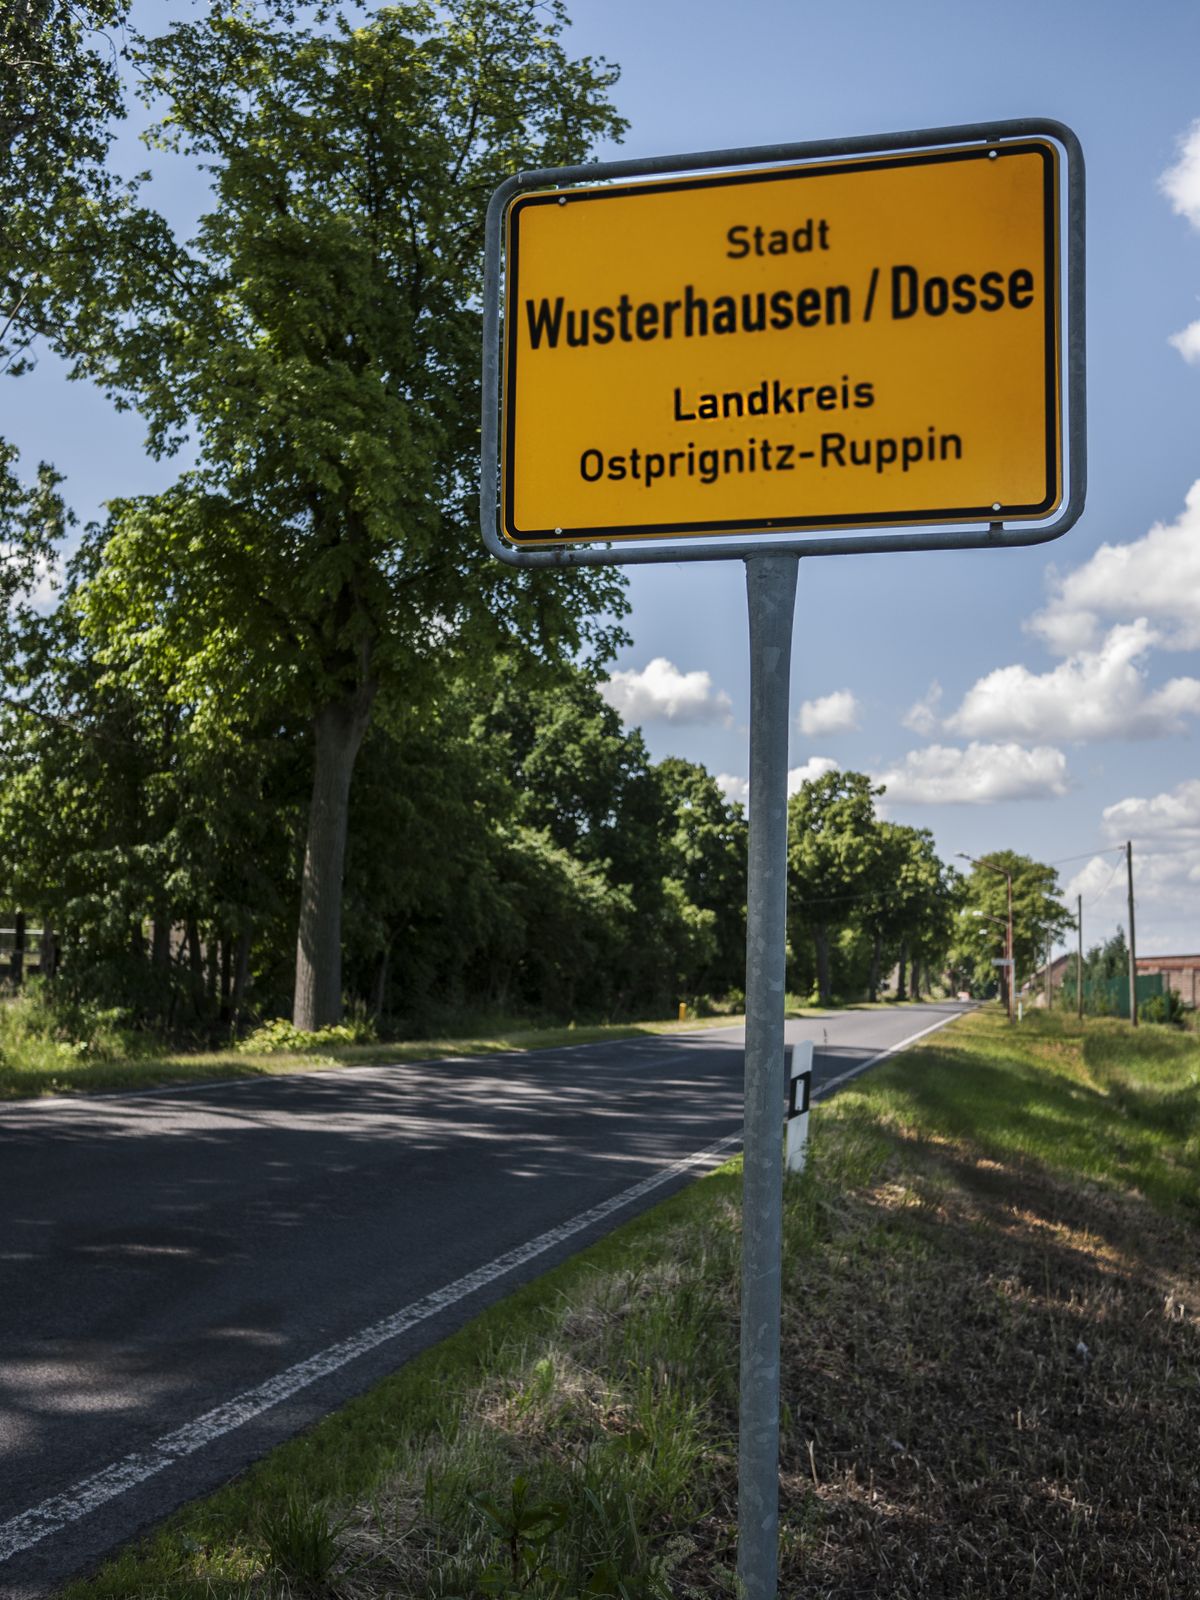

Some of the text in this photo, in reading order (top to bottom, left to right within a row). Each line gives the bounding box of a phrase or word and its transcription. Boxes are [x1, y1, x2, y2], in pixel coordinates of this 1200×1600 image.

[726, 217, 831, 260] Stadt
[674, 375, 875, 422] Landkreis
[580, 426, 962, 488] Ostprignitz-Ruppin
